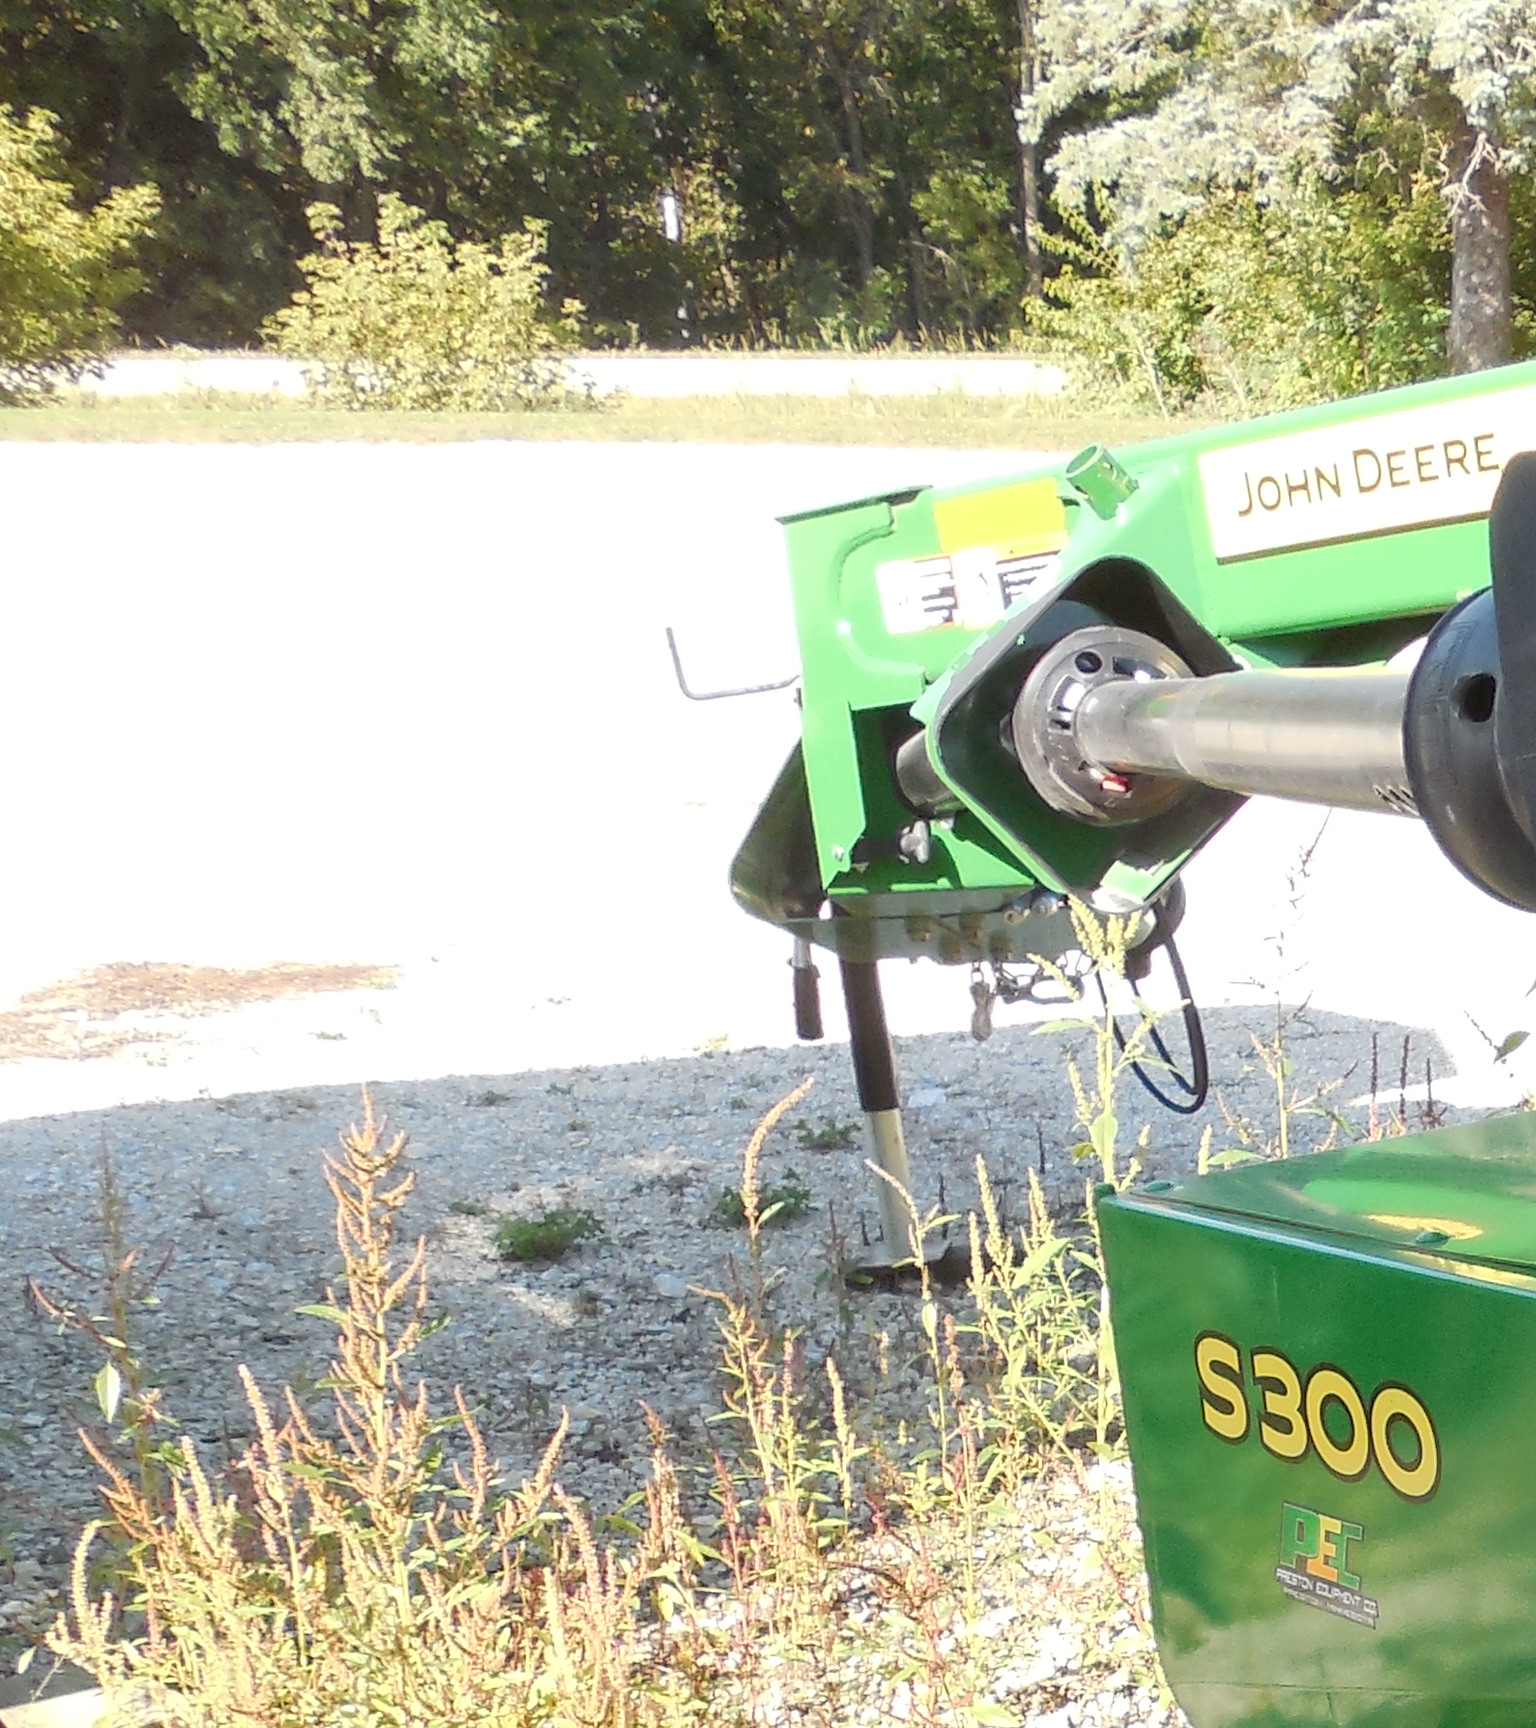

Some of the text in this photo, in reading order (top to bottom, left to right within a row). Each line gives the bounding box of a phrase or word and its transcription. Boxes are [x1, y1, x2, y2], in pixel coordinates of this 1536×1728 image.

[1238, 433, 1500, 517] JOHN DEERE
[1194, 1330, 1441, 1504] S300
